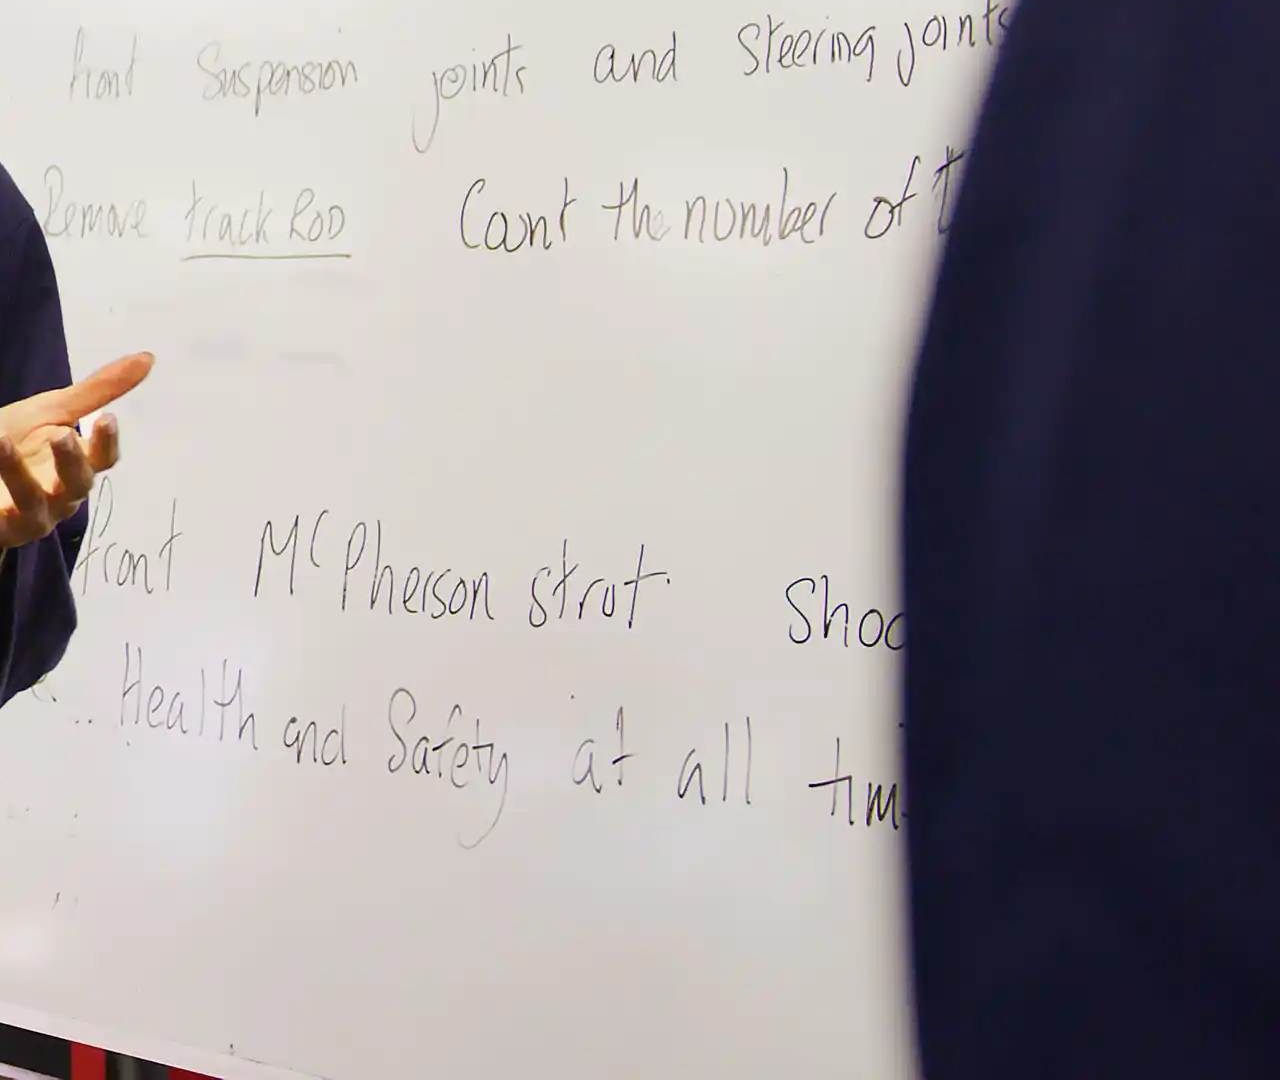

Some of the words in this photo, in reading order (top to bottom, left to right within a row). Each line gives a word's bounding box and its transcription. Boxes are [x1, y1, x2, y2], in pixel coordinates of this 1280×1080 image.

[68, 24, 140, 100] front
[412, 32, 528, 154] joints
[593, 31, 679, 84] and
[43, 164, 151, 238] Remove
[183, 179, 273, 246] track
[602, 176, 671, 242] the
[683, 167, 839, 246] number
[864, 155, 921, 240] of
[78, 476, 184, 595] front
[528, 537, 669, 629] strut
[119, 641, 259, 752] Health
[283, 703, 350, 767] and
[386, 686, 509, 850] Safety
[572, 705, 636, 794] at
[677, 716, 752, 806] all
[808, 736, 906, 831] tim
